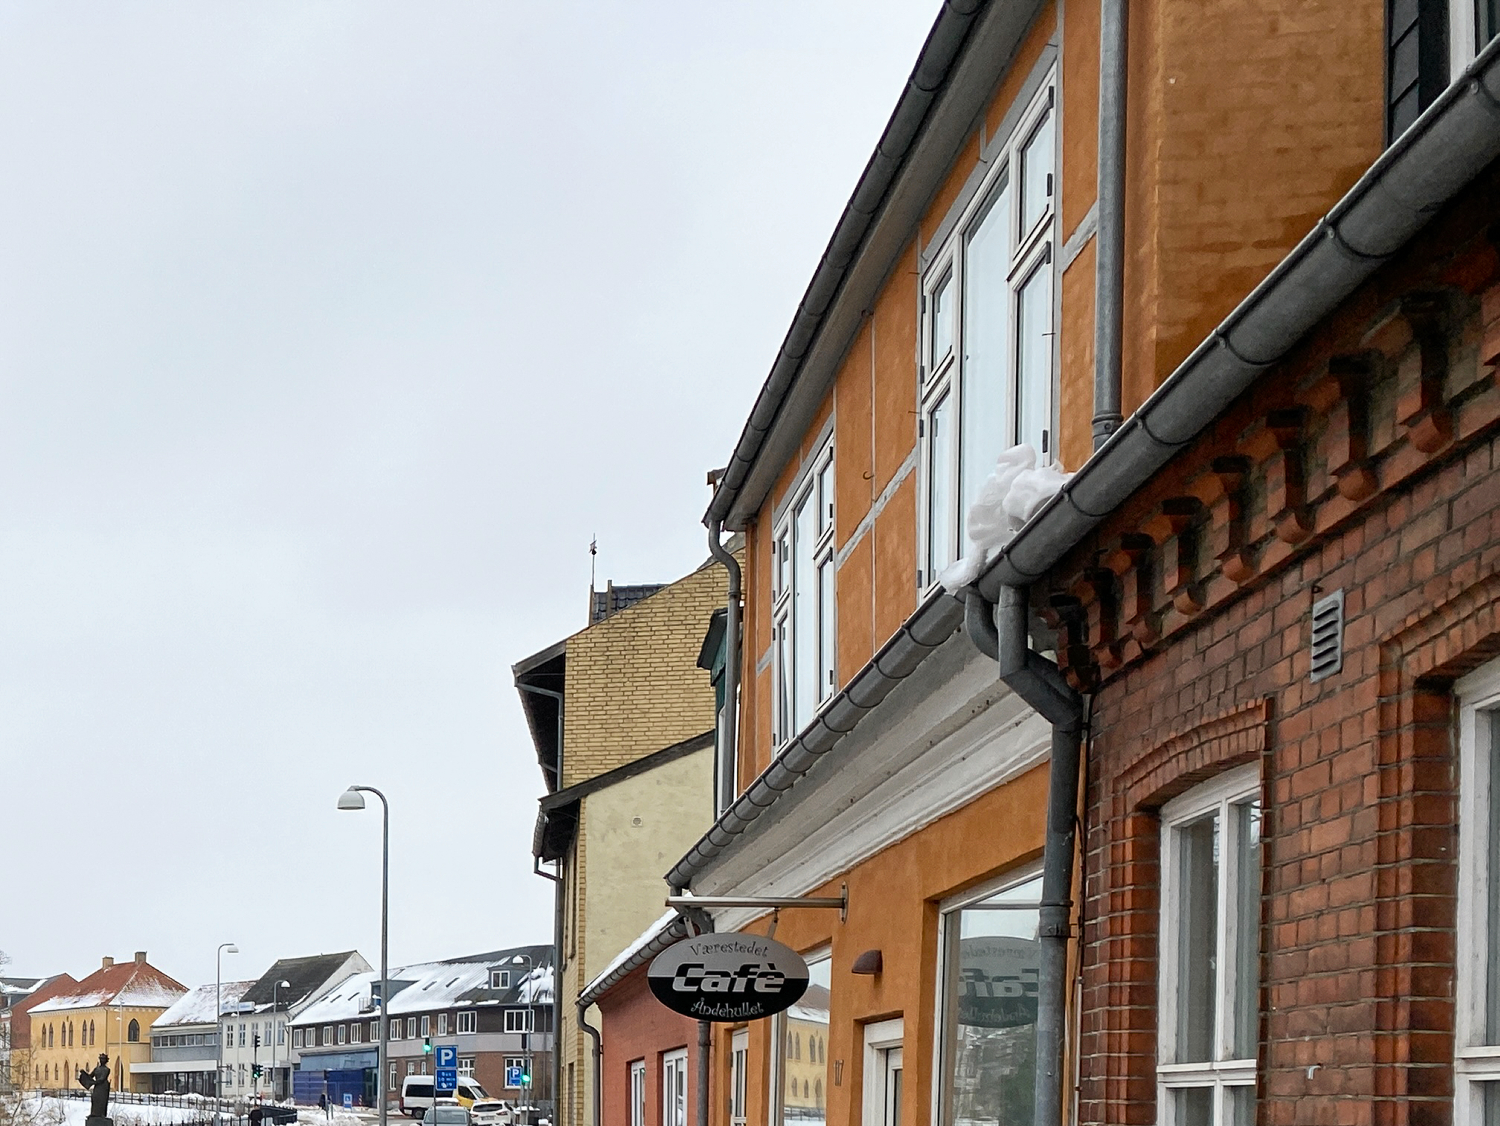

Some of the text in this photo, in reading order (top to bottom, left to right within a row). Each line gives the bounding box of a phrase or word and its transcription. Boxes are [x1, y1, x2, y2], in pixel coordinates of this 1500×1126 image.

[689, 941, 770, 958] Værestedet
[690, 996, 765, 1018] Åndehullet
[441, 1049, 453, 1065] P
[512, 1069, 520, 1078] P
